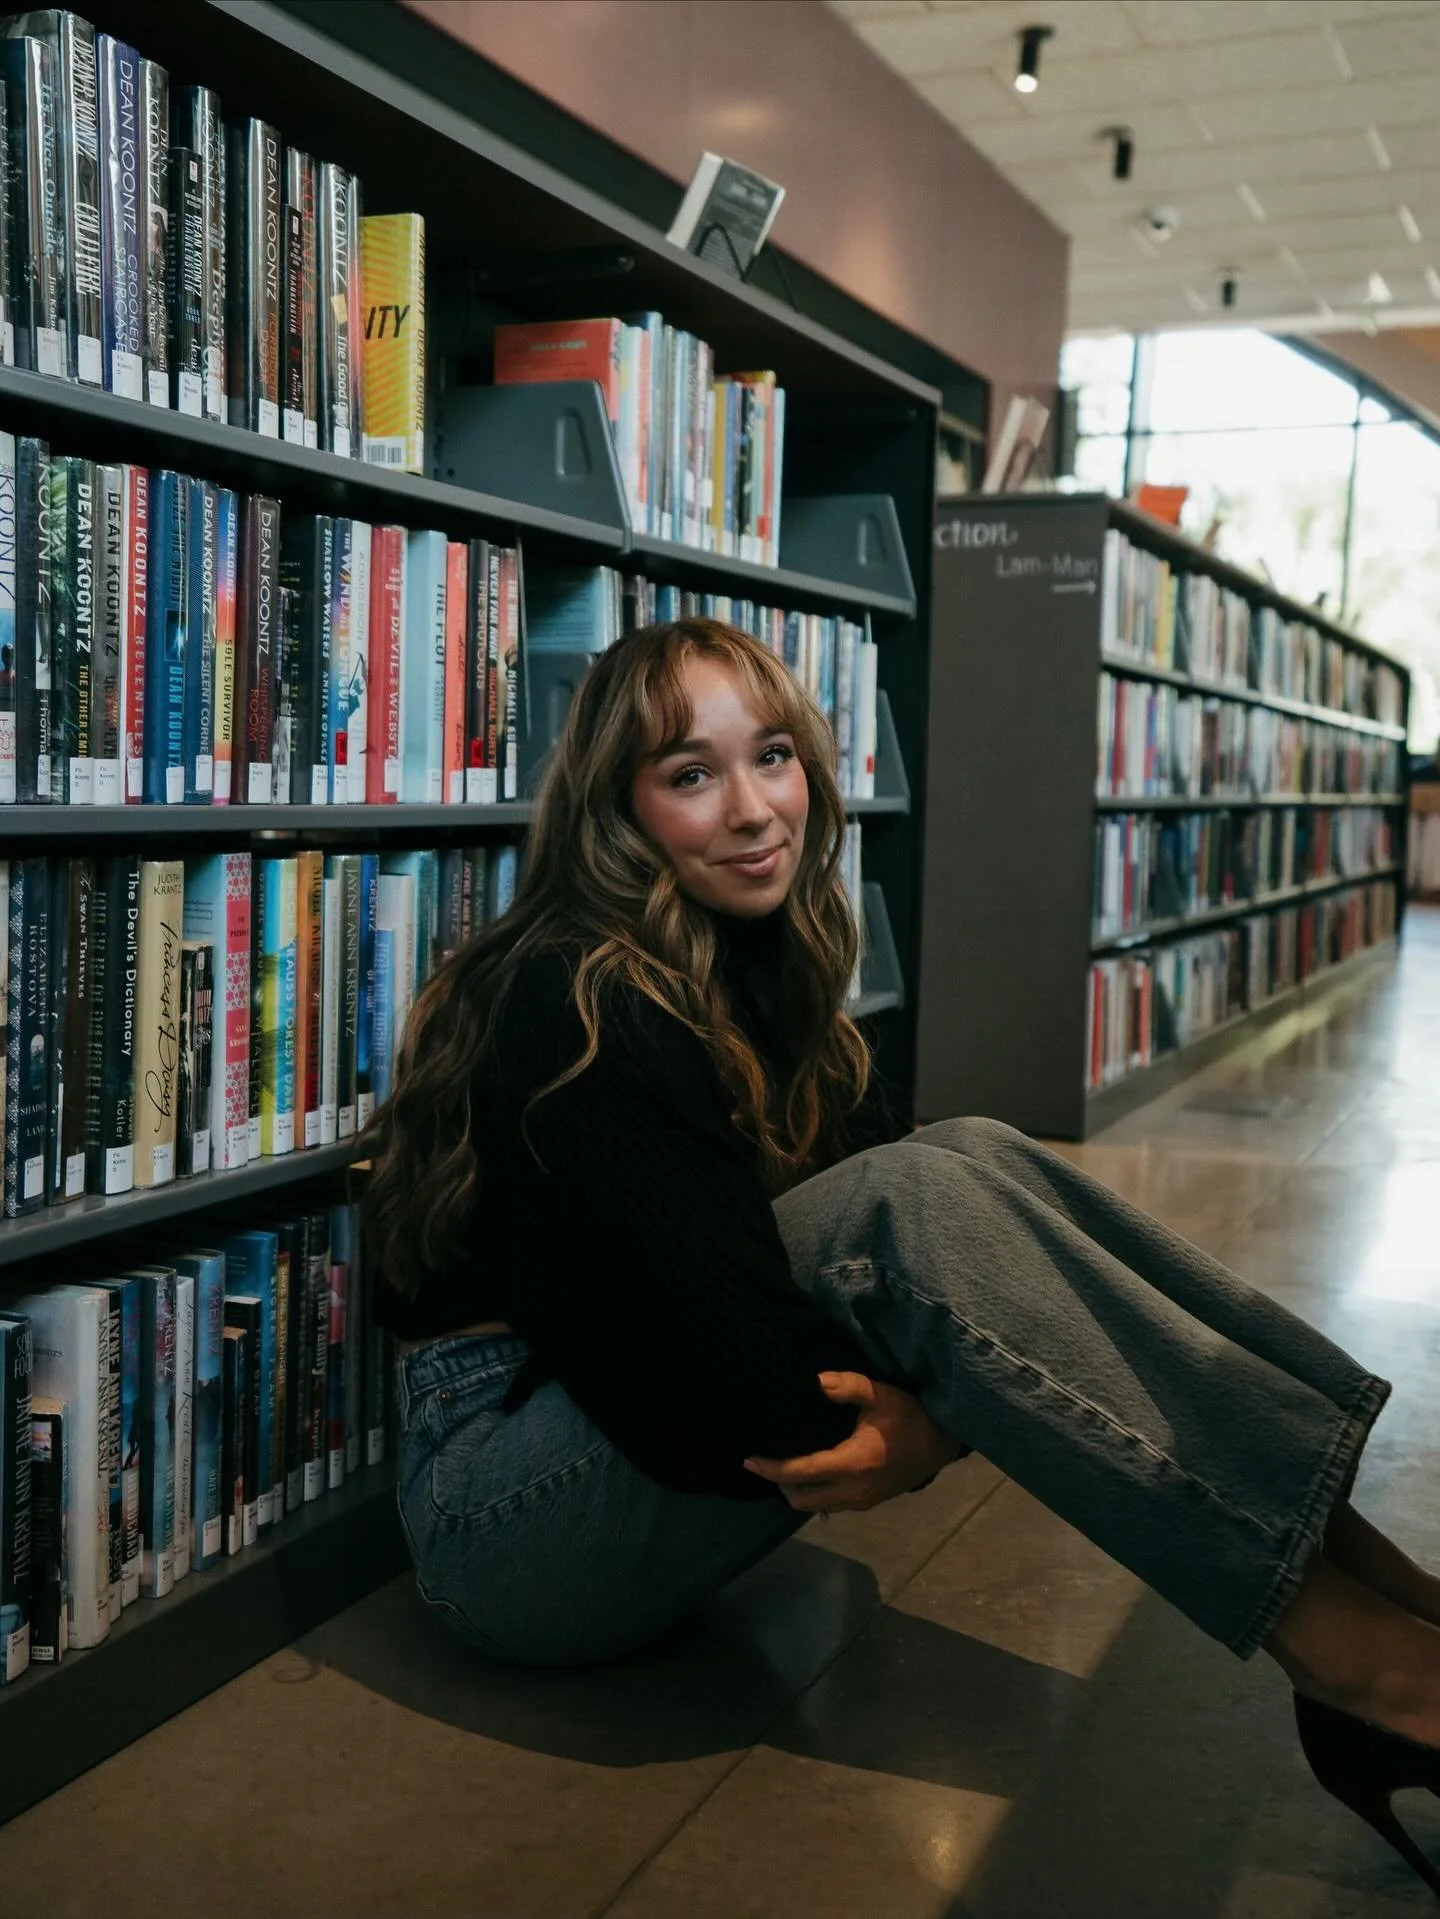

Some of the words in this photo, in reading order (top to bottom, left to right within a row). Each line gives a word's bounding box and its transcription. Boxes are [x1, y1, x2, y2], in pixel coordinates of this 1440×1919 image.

[73, 36, 96, 85] DEAN
[120, 60, 134, 133] DEAN
[43, 125, 55, 171] Nice.
[74, 97, 98, 161] KOONTZ
[149, 97, 160, 199] KOONTZ
[121, 136, 137, 236] KOONTZ
[266, 138, 277, 204] DEAN
[76, 202, 100, 253] COLD
[184, 213, 195, 292] FRANKENSTEIN
[194, 215, 202, 249] DEAN
[265, 209, 277, 301] KOONTZ
[334, 183, 347, 287] KOONTZ
[48, 273, 57, 295] Jim
[76, 254, 101, 299] FIRE
[114, 247, 127, 352] STAIRCASE
[193, 250, 203, 298] KOONTZ
[289, 269, 297, 334] FRANKENSTEIN
[127, 254, 139, 352] CROOKED
[208, 268, 222, 349] Deeply
[363, 304, 411, 339] ITY
[337, 335, 348, 360] The
[416, 329, 426, 368] DEAN
[337, 362, 348, 400] Good
[415, 376, 425, 431] KOONTZ
[77, 483, 93, 549] DEAN
[107, 492, 121, 556] DEAN
[136, 475, 147, 520] DEAN
[203, 495, 214, 542] DEAN
[38, 463, 52, 605] KOONTZ
[227, 512, 236, 547] DEAN
[260, 511, 272, 568] DEAN
[135, 526, 146, 617] KOONTZ
[202, 546, 214, 615] KOONTZ
[225, 551, 235, 604] KOONTZ
[322, 528, 333, 601] SHALLOW
[489, 555, 499, 597] NEVER
[75, 557, 92, 653] KOONTZ
[104, 563, 120, 657] KOONTZ
[258, 574, 272, 656] KOONTZ
[356, 550, 365, 640] ADMISSION
[489, 599, 499, 624] FAR
[224, 639, 233, 670] SOLE
[321, 602, 332, 658] WATERS
[489, 625, 498, 660] AWAY
[79, 664, 88, 686] THE
[168, 664, 183, 704] DEAN
[200, 659, 210, 704] SILENT
[506, 669, 517, 720] MICHAEL
[79, 690, 88, 728] OTHER
[221, 675, 232, 742] SURVIVOR
[248, 688, 259, 743] ROOM
[259, 667, 269, 763] WHISPERING
[167, 711, 182, 768] KOONTZ
[127, 871, 139, 901] The
[345, 868, 359, 919] JAYNE
[367, 879, 377, 932] KRENTZ
[126, 908, 139, 962] Devil's
[345, 921, 358, 961] ANN
[39, 912, 48, 1025] ELIZABETH
[284, 939, 295, 1001] KRAUSS
[120, 969, 137, 1056] Dictionary
[344, 967, 358, 1038] KRENTZ
[284, 1007, 295, 1066] FOREST
[145, 1022, 178, 1134] Daisy
[115, 1100, 127, 1139] Kotler
[98, 1317, 109, 1371] JAYNE
[109, 1309, 121, 1365] JAYNE
[164, 1312, 175, 1377] KRENTZ
[207, 1282, 220, 1356] KRENTZ
[312, 1323, 329, 1377] Family
[98, 1375, 109, 1413] ANN
[109, 1372, 121, 1410] ANN
[15, 1393, 33, 1457] JAYNE
[15, 1458, 32, 1505] ANN
[13, 1505, 31, 1585] KRENTZ
